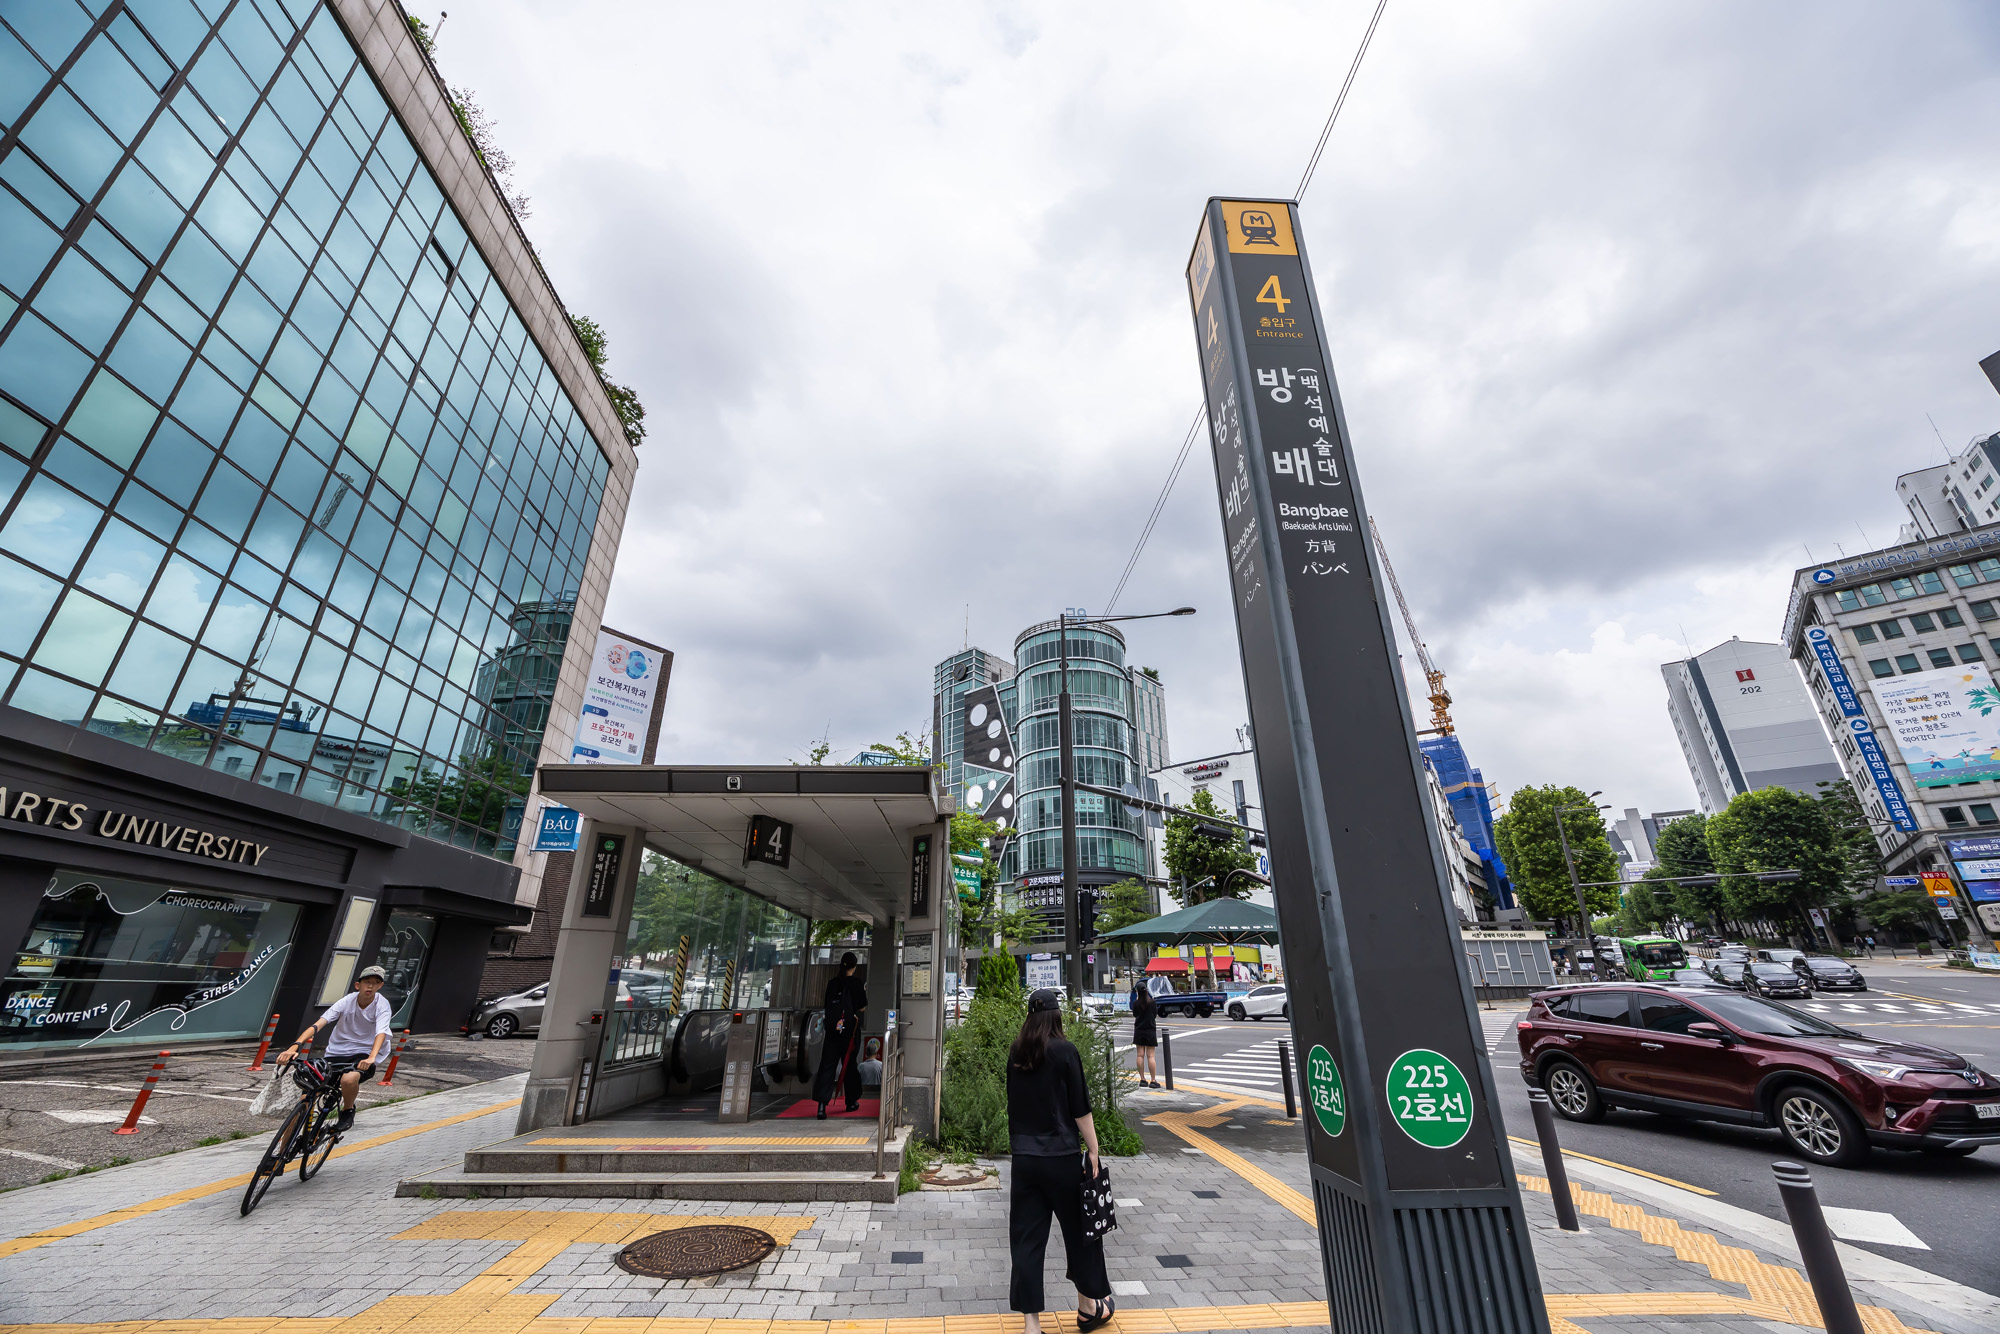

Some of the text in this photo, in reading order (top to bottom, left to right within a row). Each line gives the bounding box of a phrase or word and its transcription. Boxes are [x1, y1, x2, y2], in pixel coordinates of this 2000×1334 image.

[1256, 275, 1291, 313] 4
[1207, 305, 1218, 349] 4
[1260, 316, 1296, 328] 출입구
[1256, 329, 1304, 339] Entrance
[1279, 503, 1349, 520] Bangbae
[1282, 521, 1353, 532] (Baekseok Arts Univ.)
[1232, 517, 1256, 560] Bangbae
[1305, 539, 1336, 553] 方背
[1841, 529, 2000, 575] 백석대학교 신학교육
[1302, 561, 1350, 575] パンベ
[1817, 643, 1857, 710] 백석대학교 대학원
[597, 676, 647, 698] 보건복지학과
[1740, 686, 1762, 695] 202
[1884, 699, 1902, 707] 가장
[1905, 694, 1929, 703] 뜨거운
[1931, 691, 1950, 699] 계절
[1908, 703, 1933, 712] 빛나는
[1935, 699, 1952, 708] 우리
[604, 719, 625, 729] 보건복지
[1894, 717, 1919, 725] 뜨거운
[1941, 711, 1962, 719] 아래
[590, 722, 635, 740] 프로그램 기획
[1898, 722, 1949, 735] 우리의 청춘도
[600, 734, 622, 747] 공모전
[1859, 736, 1913, 828] 백석대학교 신학교육원
[100, 811, 269, 866] UNIVERSITY
[768, 826, 782, 855] 4
[1029, 875, 1060, 886] 고운치과의원
[165, 895, 247, 914] CHOREOGRAPHY
[202, 944, 273, 1001] STREET DANCE
[5, 996, 56, 1010] DANCE
[35, 1003, 108, 1025] CONTENTS
[1312, 1059, 1333, 1082] 225
[1403, 1065, 1448, 1088] 225
[1312, 1085, 1343, 1117] 2호선
[1397, 1093, 1467, 1122] 2호선
